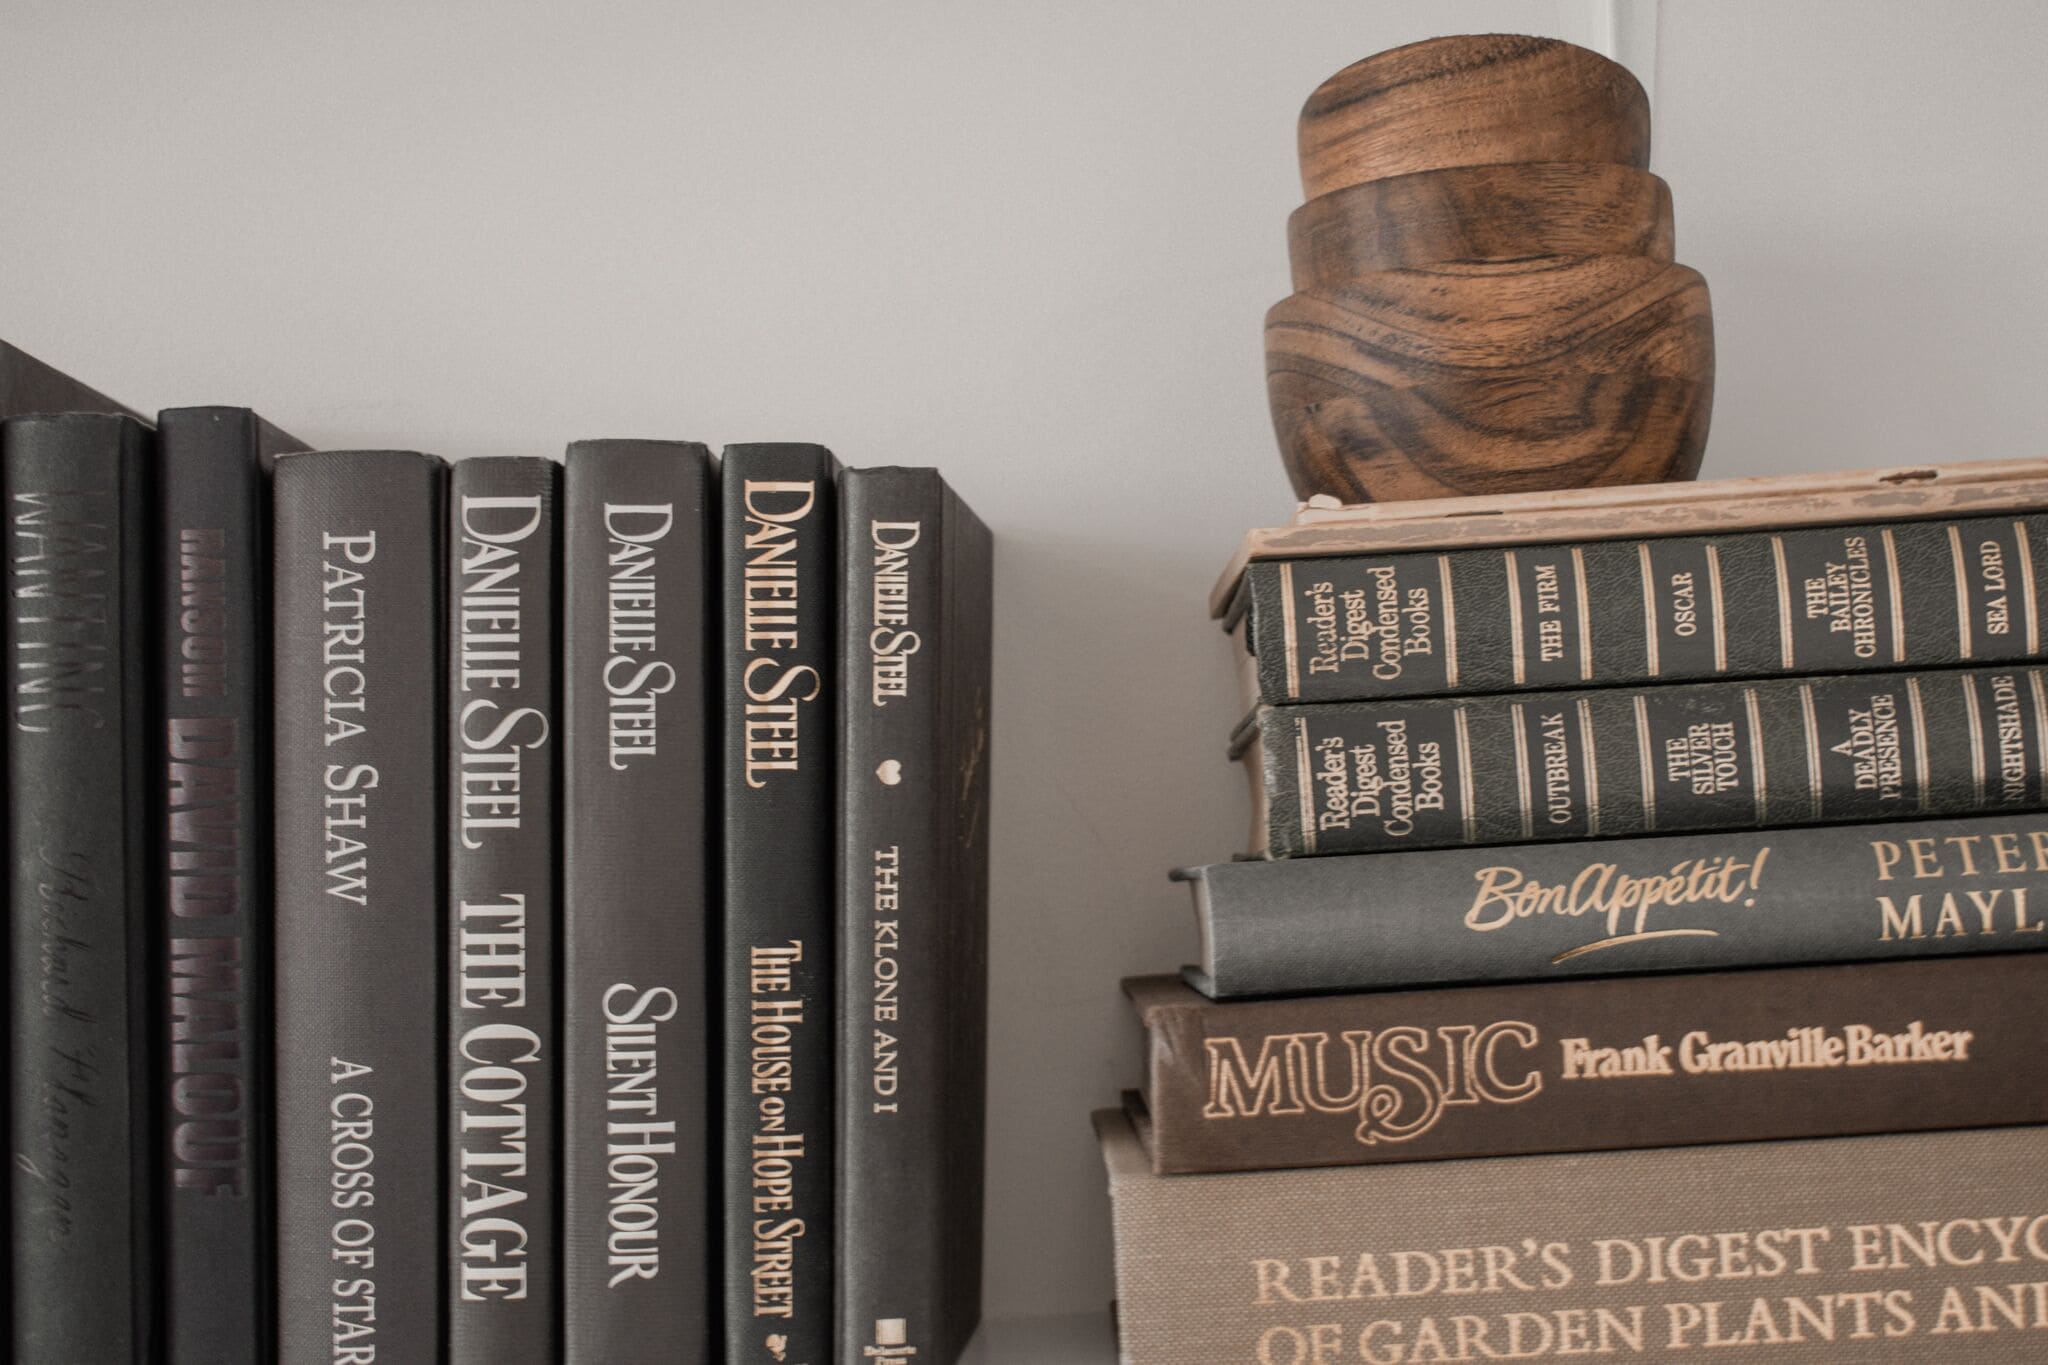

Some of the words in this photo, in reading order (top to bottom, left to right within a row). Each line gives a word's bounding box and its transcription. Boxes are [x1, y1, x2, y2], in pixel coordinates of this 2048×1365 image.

[461, 494, 541, 692] DANIELLE
[604, 502, 673, 653] DANIELLE
[744, 479, 816, 651] DANIELLE
[871, 520, 920, 626] DANIELLE
[1535, 564, 1559, 613] FIRM
[1672, 572, 1697, 637] OSCAR
[1805, 578, 1828, 619] THE
[1825, 562, 1852, 633] BAILEY
[1844, 536, 1877, 658] CHRONICLES
[1980, 540, 2006, 591] LORD
[180, 528, 227, 697] RANSOM
[322, 530, 376, 746] PATRICIA
[1306, 582, 1339, 674] Reader's
[1340, 589, 1371, 661] Digest
[1367, 565, 1402, 680] Condensed
[1404, 587, 1432, 655] Books
[1541, 620, 1563, 662] THE
[1986, 595, 2009, 635] SEA
[870, 627, 921, 707] STEEL
[603, 655, 676, 771] STEEL
[743, 656, 821, 788] STEEL
[1710, 722, 1738, 791] TOUCH
[1831, 740, 1852, 755] A
[1848, 709, 1878, 791] DEADLY
[1872, 695, 1901, 800] PRESENCE
[1991, 675, 2026, 801] NIGHTSHADE
[459, 699, 549, 850] STEEL
[1315, 736, 1351, 831] Reader's
[1349, 744, 1382, 817] Digest
[1376, 719, 1413, 837] Condensed
[1415, 741, 1444, 811] Books
[1542, 712, 1571, 824] OUTBREAK
[1666, 738, 1690, 782] THE
[1687, 724, 1716, 795] SILVER
[168, 718, 239, 918] DAVID
[325, 764, 379, 906] SHAW
[875, 846, 899, 911] THE
[1875, 887, 2044, 941] MAYL
[459, 894, 526, 1009] THE
[751, 940, 802, 993] THE
[874, 919, 898, 1022] KLONE
[171, 937, 247, 1197] MALOUF
[331, 1056, 373, 1084] A
[602, 983, 678, 1116] SILENT
[751, 1000, 803, 1094] HOUSE
[873, 1029, 899, 1097] AND
[1204, 1021, 1542, 1144] MUSIC
[1560, 1034, 1674, 1078] Frank
[1678, 1027, 1845, 1074] Granville
[1844, 1020, 1973, 1066] Barker
[331, 1093, 374, 1208] CROSS
[758, 1097, 786, 1132] ON
[873, 1102, 898, 1114] I
[459, 1023, 542, 1300] COTTAGE
[607, 1120, 676, 1289] HONOUR
[752, 1133, 804, 1213] HOPE
[332, 1218, 375, 1269] OF
[751, 1218, 805, 1318] STREET
[1251, 1238, 1573, 1303] READER'S
[1593, 1226, 1829, 1285] DIGEST
[1258, 1322, 1342, 1365] OF
[1358, 1305, 1645, 1365] GARDEN
[1665, 1289, 1916, 1351] PLANTS
